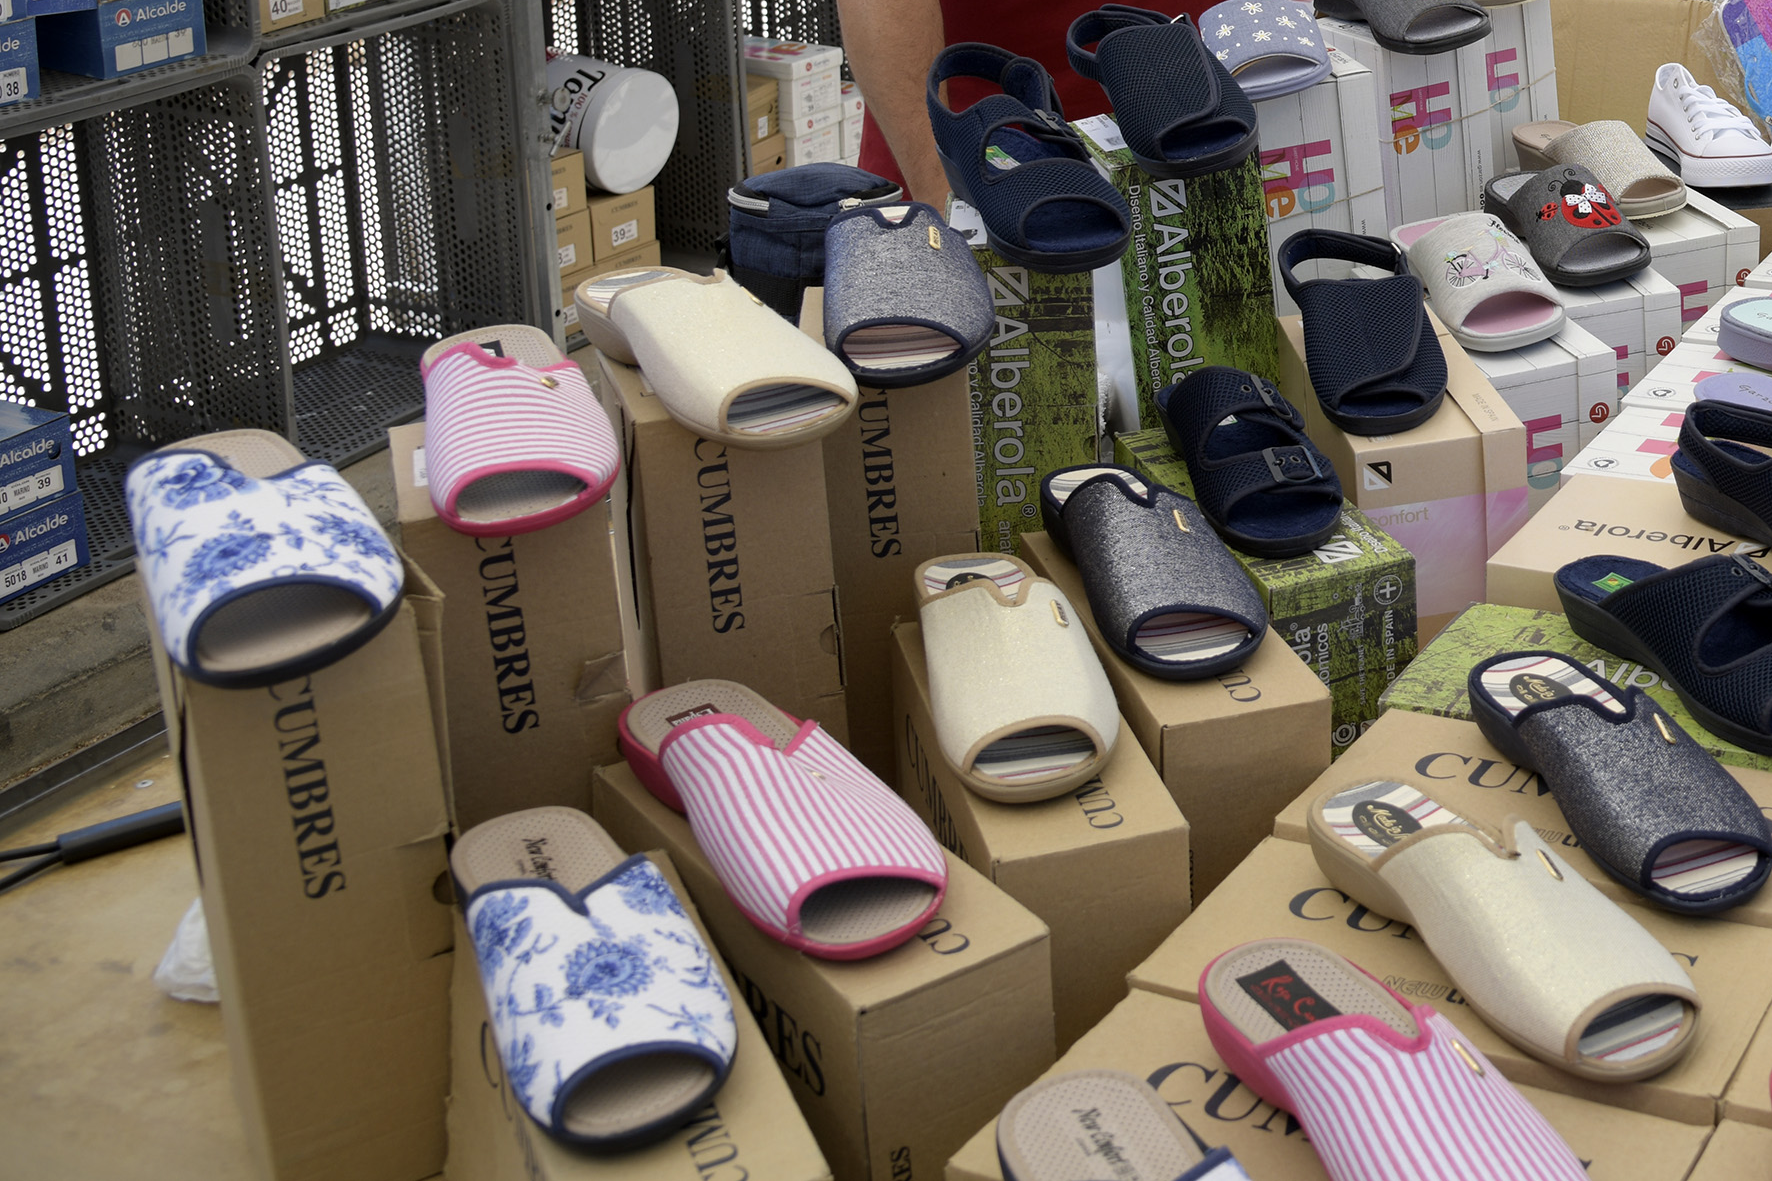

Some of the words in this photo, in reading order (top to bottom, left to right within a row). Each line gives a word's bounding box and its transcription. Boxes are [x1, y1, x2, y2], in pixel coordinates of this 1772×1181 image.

[136, 0, 187, 22] Alcalde
[6, 81, 20, 97] 38
[1128, 185, 1143, 231] Diseño
[613, 228, 626, 243] 39
[1134, 233, 1149, 285] Italiano
[1142, 294, 1158, 345] Calidad
[970, 391, 985, 444] Calidad
[0, 439, 55, 467] Alcalde
[13, 485, 31, 497] MARINO
[37, 477, 51, 490] 39
[973, 446, 991, 507] Alberola
[15, 514, 69, 546] Alcalde
[1573, 518, 1735, 554] Alberola
[4, 570, 28, 588] 5018
[55, 552, 69, 565] 41
[1385, 609, 1395, 646] SPAIN
